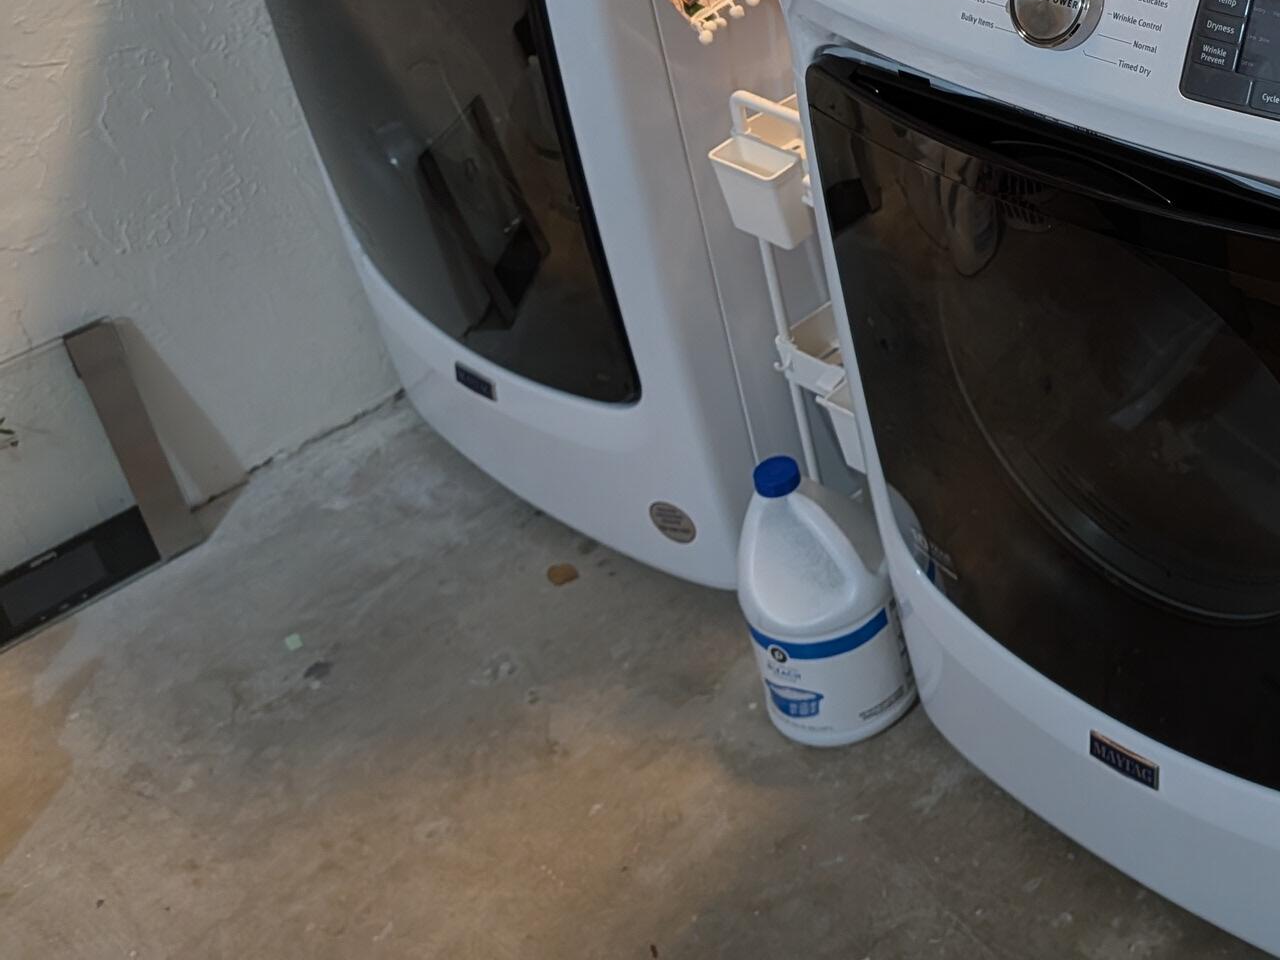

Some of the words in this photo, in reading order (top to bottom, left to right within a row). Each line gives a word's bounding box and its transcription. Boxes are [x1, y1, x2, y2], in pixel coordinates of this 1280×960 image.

[961, 12, 977, 25] Bulky
[978, 17, 994, 29] Items
[1112, 11, 1137, 25] Wrinkle
[1138, 19, 1162, 32] Control
[1206, 20, 1235, 34] Dryness
[1133, 40, 1157, 54] Normal
[1203, 44, 1227, 57] Wrinkle
[1201, 53, 1225, 66] Prevent
[1118, 59, 1138, 72] Timed
[1139, 66, 1152, 77] Dry
[1262, 93, 1280, 104] Cycle
[1094, 741, 1153, 783] MAYTAG
